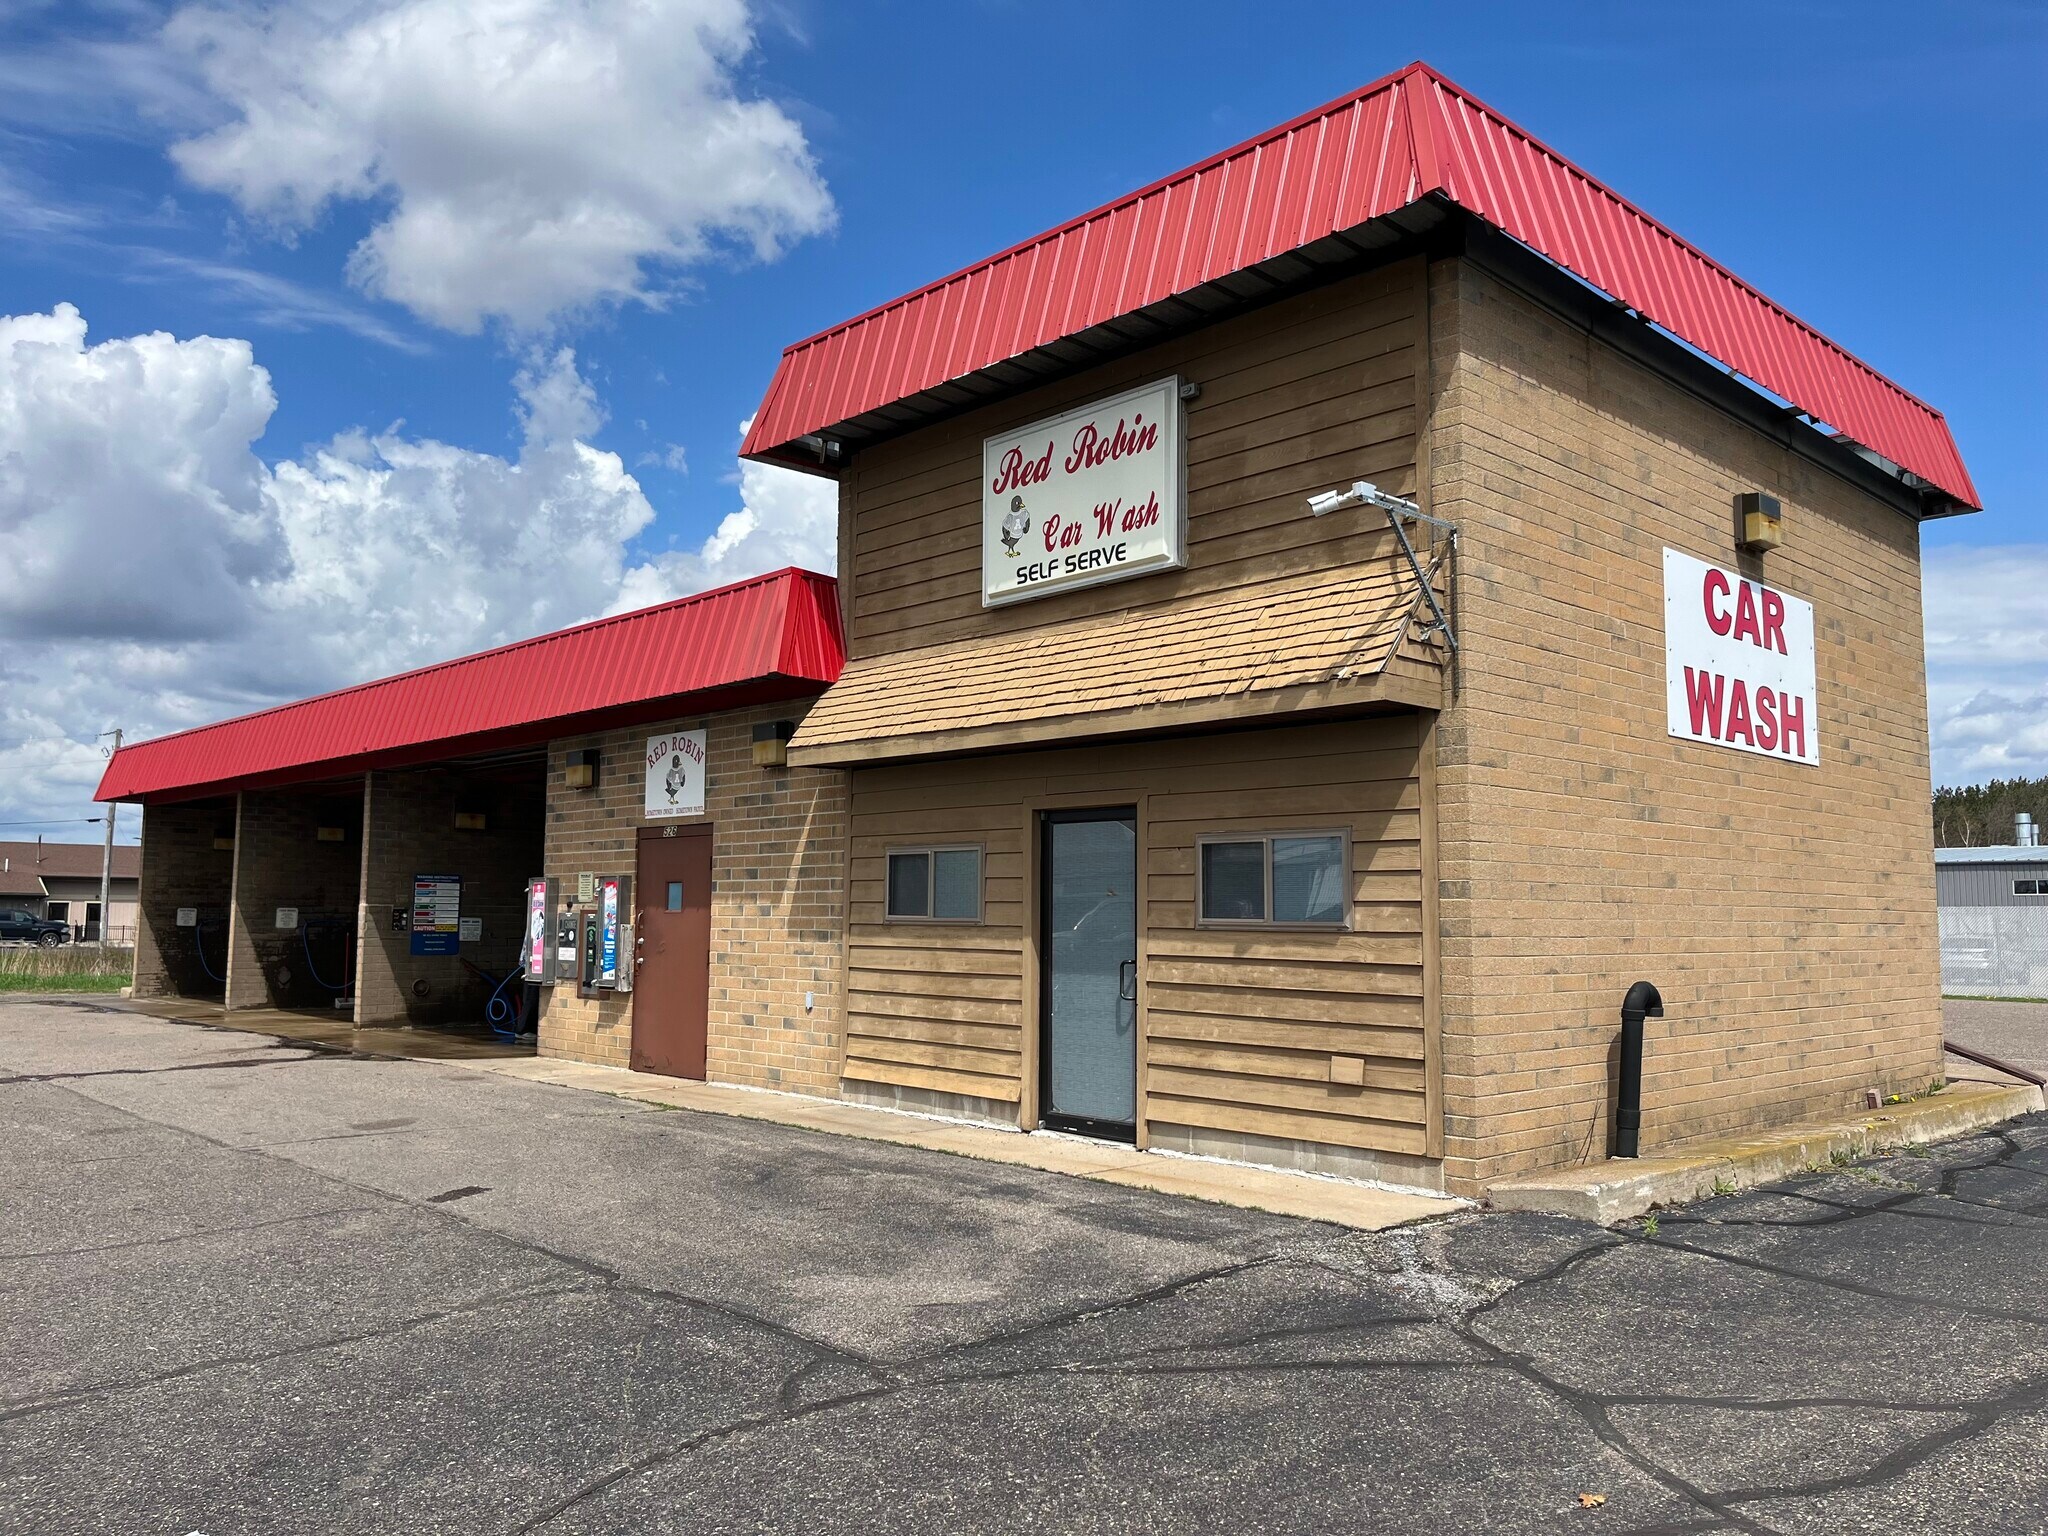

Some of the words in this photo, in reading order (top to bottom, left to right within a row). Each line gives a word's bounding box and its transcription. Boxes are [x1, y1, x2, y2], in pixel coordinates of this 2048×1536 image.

[993, 441, 1054, 495] Red
[1065, 413, 1158, 474] Robin
[1043, 514, 1083, 552] Car
[1094, 491, 1160, 539] Wash
[1017, 559, 1059, 585] SELF
[1065, 542, 1127, 573] SERVE
[1703, 568, 1788, 656] CAR
[1683, 666, 1806, 757] WASH
[647, 741, 668, 769] RED
[672, 737, 704, 765] ROBIN
